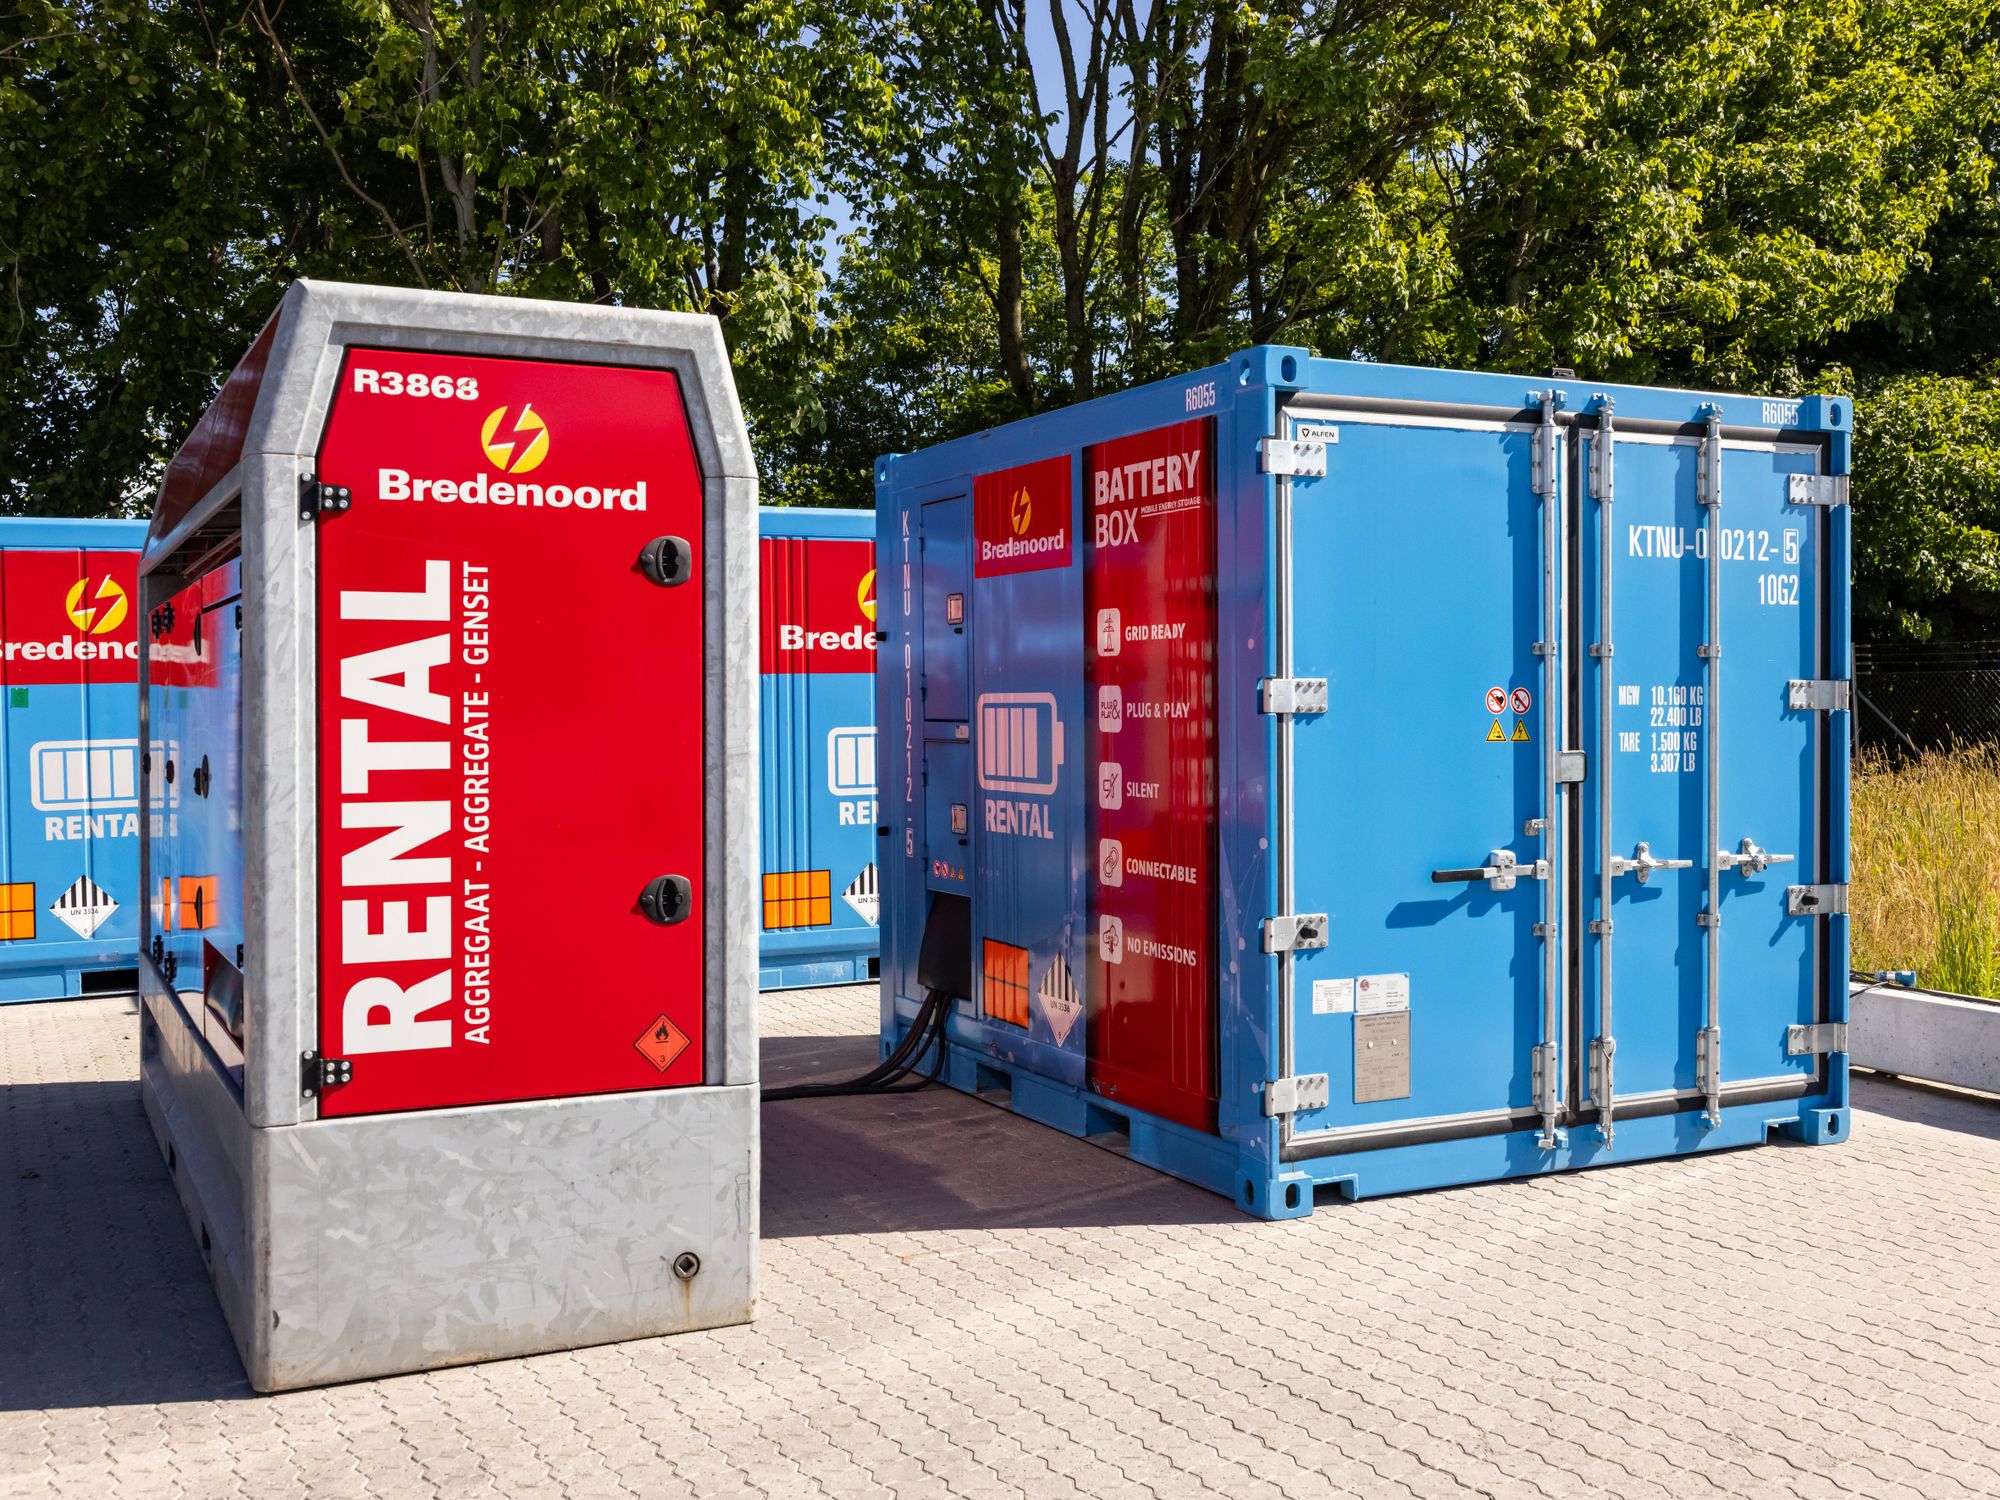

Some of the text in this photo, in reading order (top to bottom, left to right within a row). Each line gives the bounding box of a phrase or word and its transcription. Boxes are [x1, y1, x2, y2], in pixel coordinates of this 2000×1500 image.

[1185, 382, 1215, 412] R6055
[1762, 402, 1799, 426] R6055
[378, 468, 647, 511] Bredenoord
[1095, 450, 1200, 506] BATTERY
[1095, 507, 1139, 548] BOX
[982, 529, 1064, 561] Bredenoord
[1758, 574, 1799, 606] 10G2
[463, 561, 490, 665] GENSET
[1125, 622, 1186, 642] GRID READY
[1126, 702, 1190, 719] PLUG & PLAY
[1618, 685, 1704, 706] MGW 10.160 KG
[1650, 706, 1702, 727] 22.400 LB
[1618, 731, 1697, 752] TARE 1.500 KG
[463, 691, 490, 853] AGGREGATE
[1650, 752, 1696, 773] 3.307 LB
[1126, 781, 1160, 799] SILENT
[340, 559, 452, 1055] RENTAL
[985, 799, 1054, 840] RENTAL
[1126, 857, 1197, 884] CONNECTABLE
[463, 879, 491, 1045] AGGREGAAT
[1127, 937, 1197, 967] NO EMISSIONS
[1050, 1001, 1058, 1010] UN
[659, 1054, 666, 1063] 3
